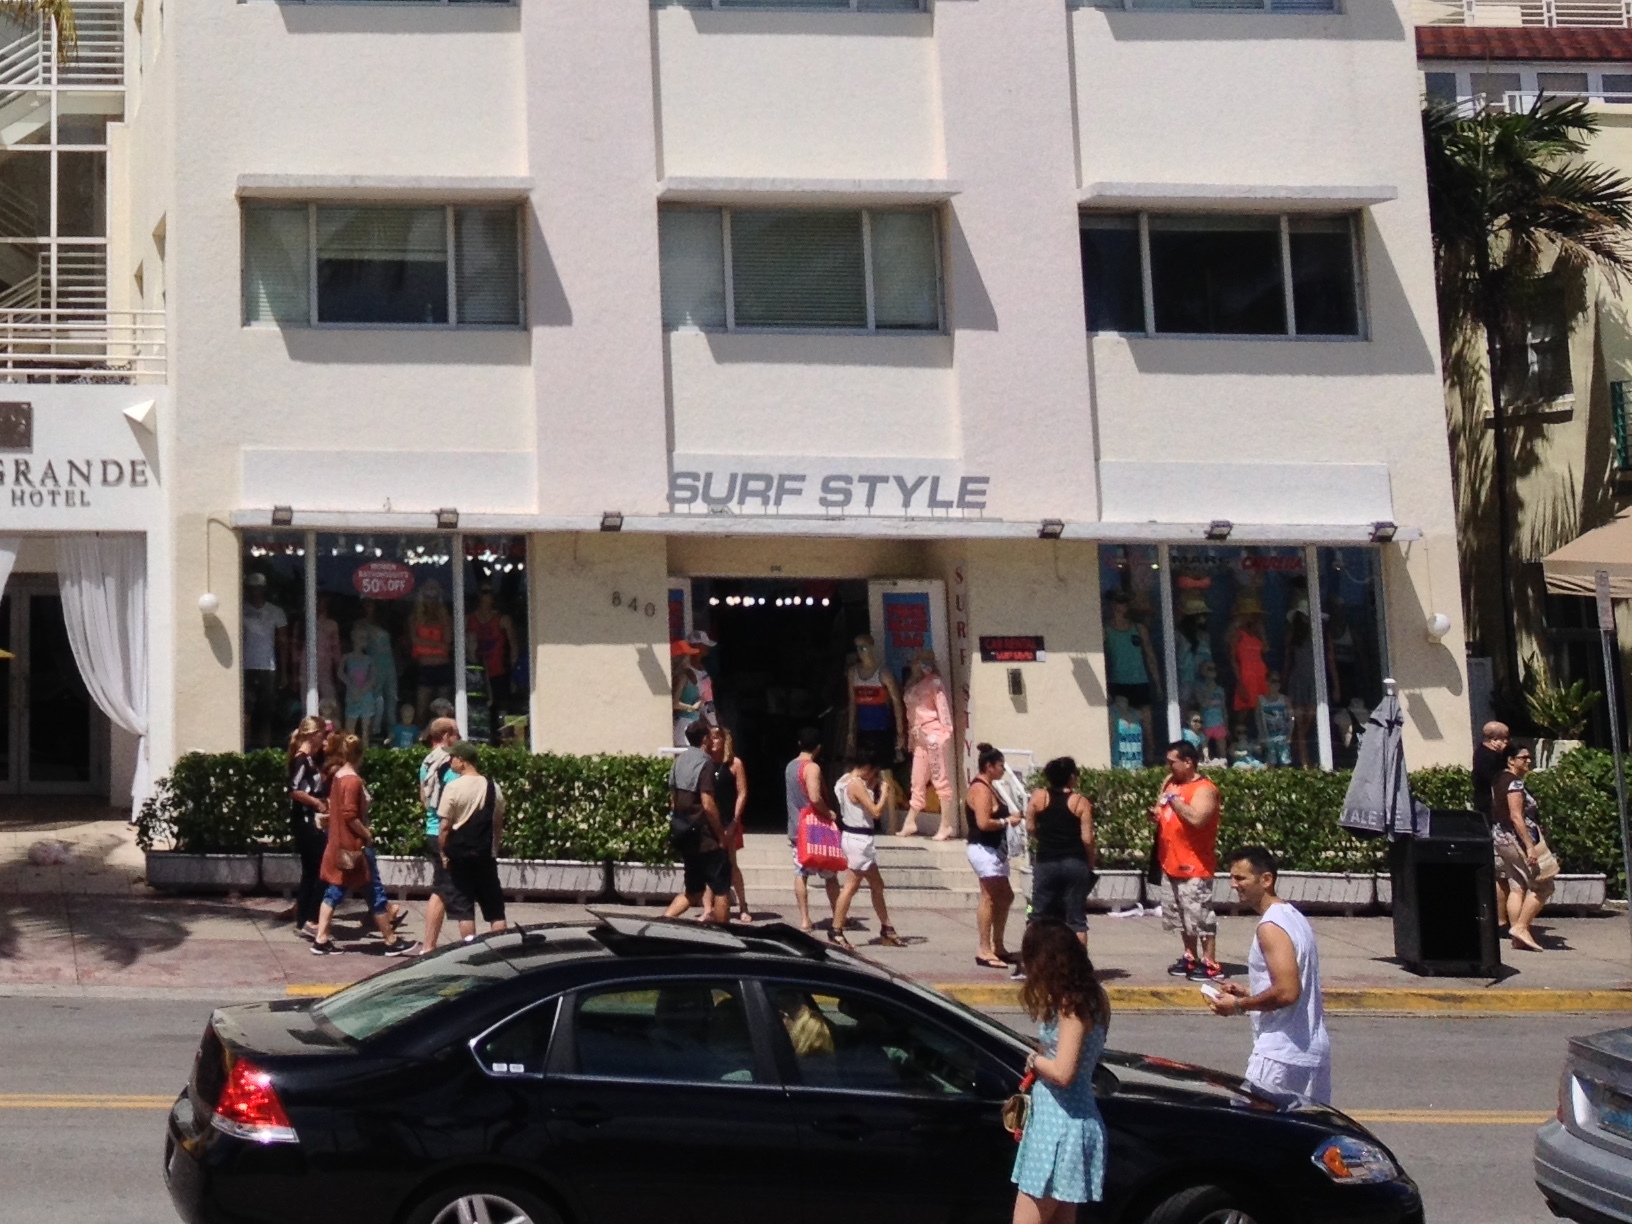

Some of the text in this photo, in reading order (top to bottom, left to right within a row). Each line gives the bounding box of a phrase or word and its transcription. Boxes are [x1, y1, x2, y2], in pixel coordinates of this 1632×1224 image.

[11, 488, 92, 508] HOTEL
[666, 471, 991, 509] SURF STYLE
[388, 579, 406, 591] OFF
[611, 590, 656, 618] 840
[954, 566, 967, 665] SURF
